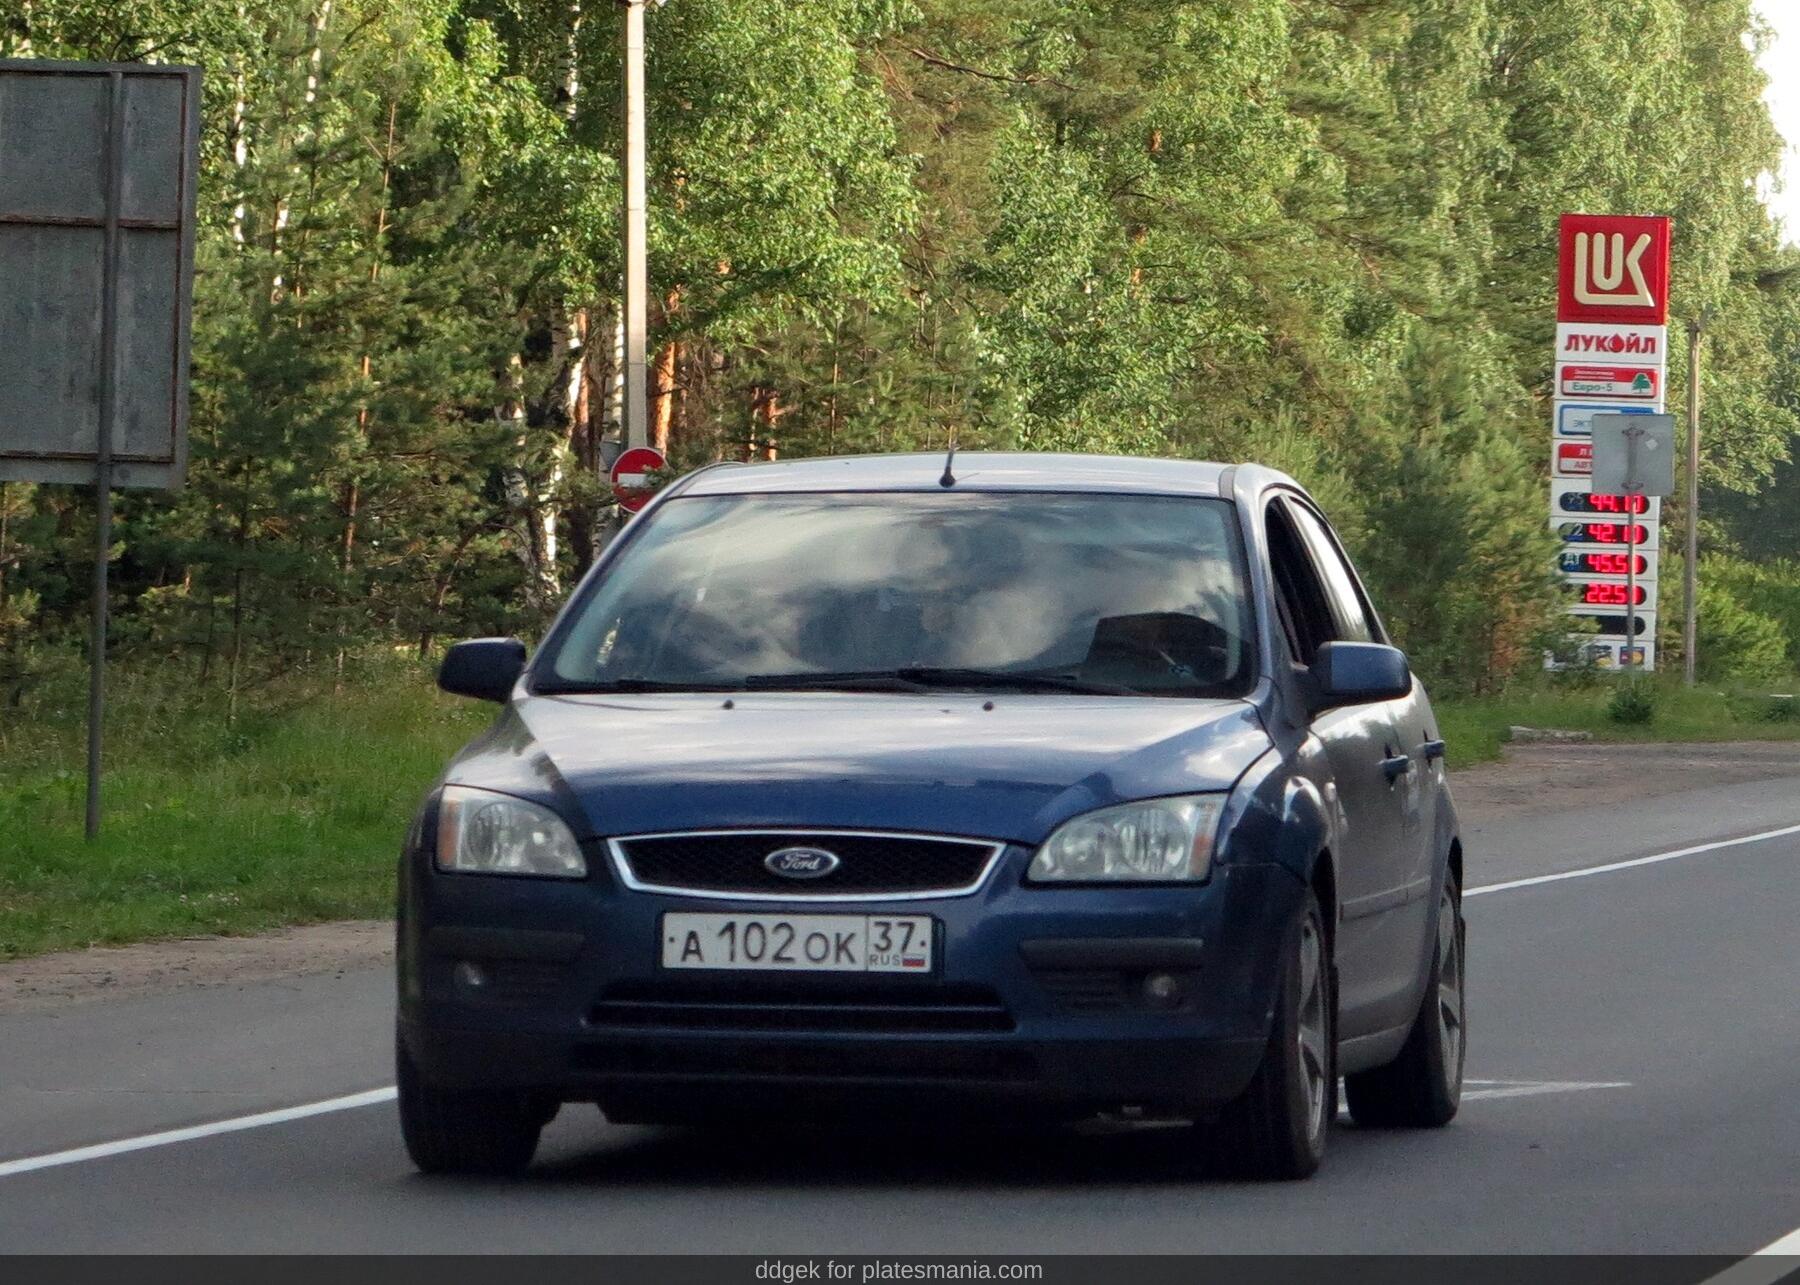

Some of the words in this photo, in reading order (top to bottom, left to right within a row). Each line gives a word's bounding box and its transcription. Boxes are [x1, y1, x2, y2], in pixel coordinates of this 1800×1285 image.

[1564, 333, 1656, 354] ЛУКОЙЛ
[780, 853, 821, 871] Ford
[873, 921, 917, 953] 37
[869, 955, 900, 966] RUS
